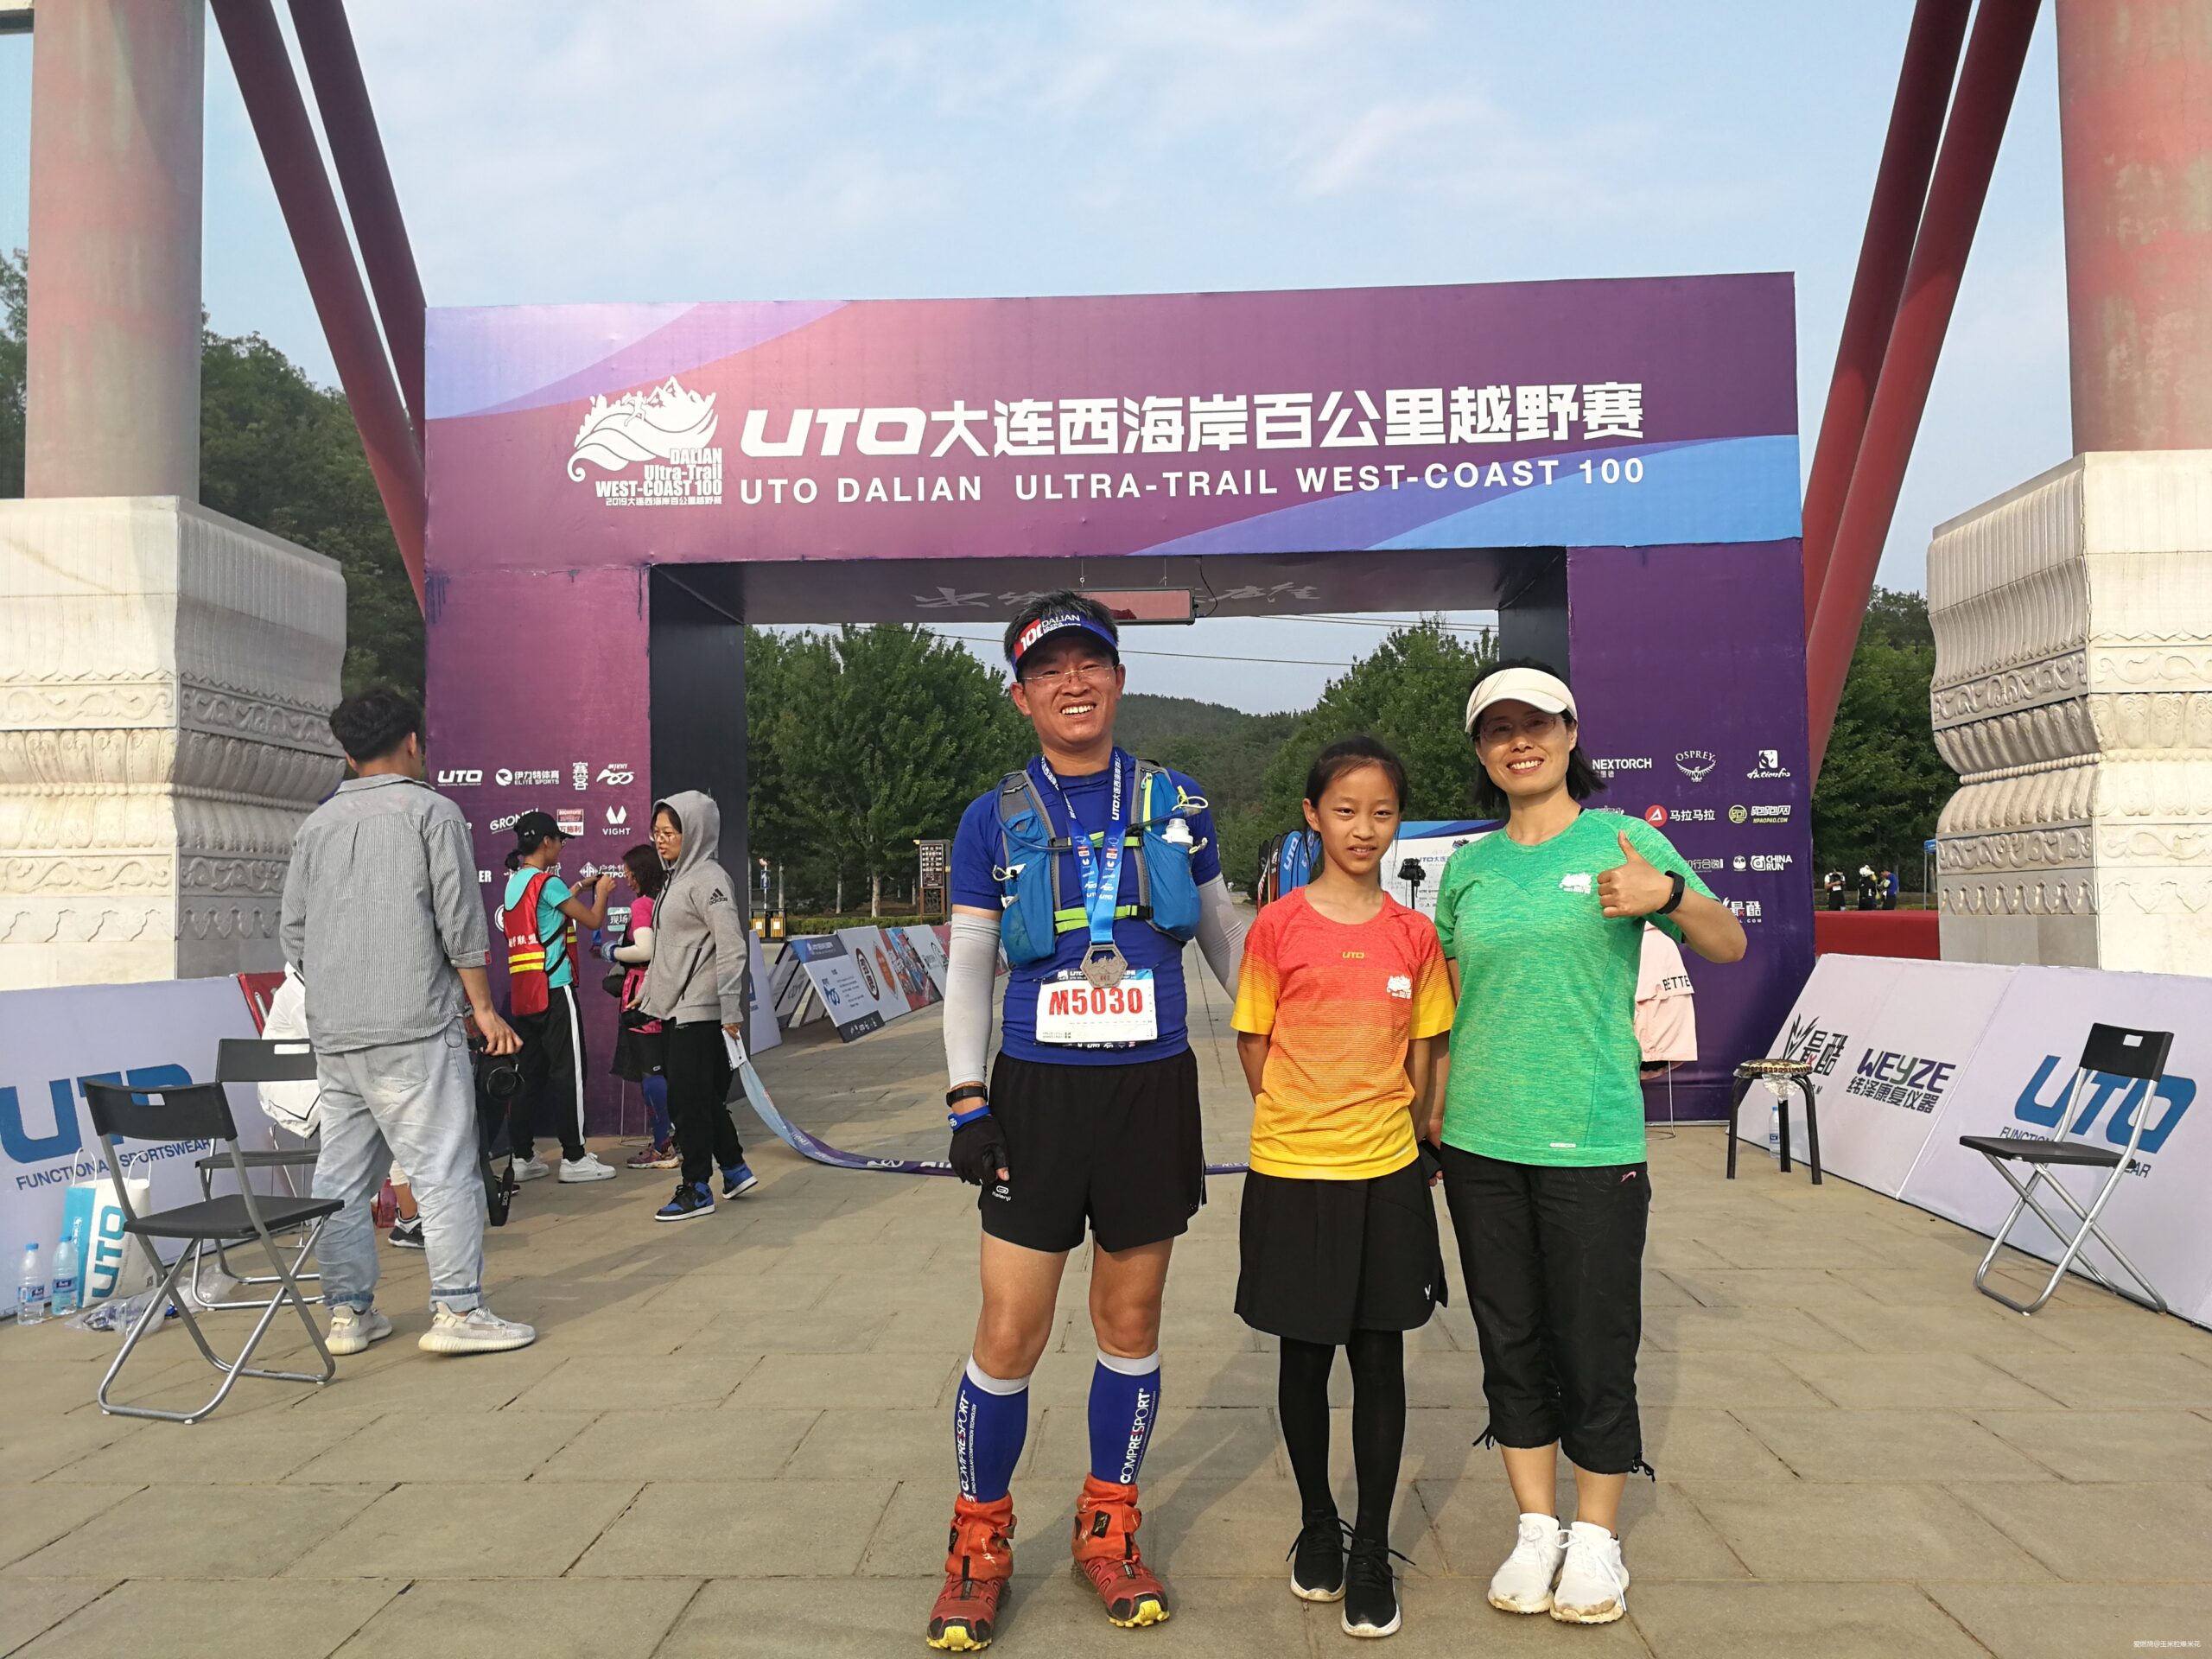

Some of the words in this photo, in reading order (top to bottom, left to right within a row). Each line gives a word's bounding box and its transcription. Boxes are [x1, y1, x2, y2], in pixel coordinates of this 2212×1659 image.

[670, 448, 722, 464] DALIAN
[644, 463, 722, 480] Ultra-Trail
[595, 480, 692, 497] WEST-COAST
[695, 480, 722, 496] 100
[741, 478, 819, 504] UTO
[837, 474, 982, 503] DALIAN
[1015, 469, 1277, 500] ULTRA-TRAIL
[1296, 459, 1558, 493] WEST-COAST
[1580, 457, 1643, 484] 100
[1042, 614, 1080, 627] DALIAN
[1592, 758, 1652, 770] NEXTORCH
[1675, 750, 1716, 762] OSPREY
[437, 769, 483, 783] UTO
[1669, 810, 1715, 821] 马拉马拉
[1049, 986, 1143, 1015] M5030
[1846, 1076, 1940, 1114] 纬泽康复仪器
[16, 1159, 111, 1191] FUNCTIONA
[119, 1139, 213, 1167] SPORTSWEAR
[92, 1205, 126, 1298] UTO
